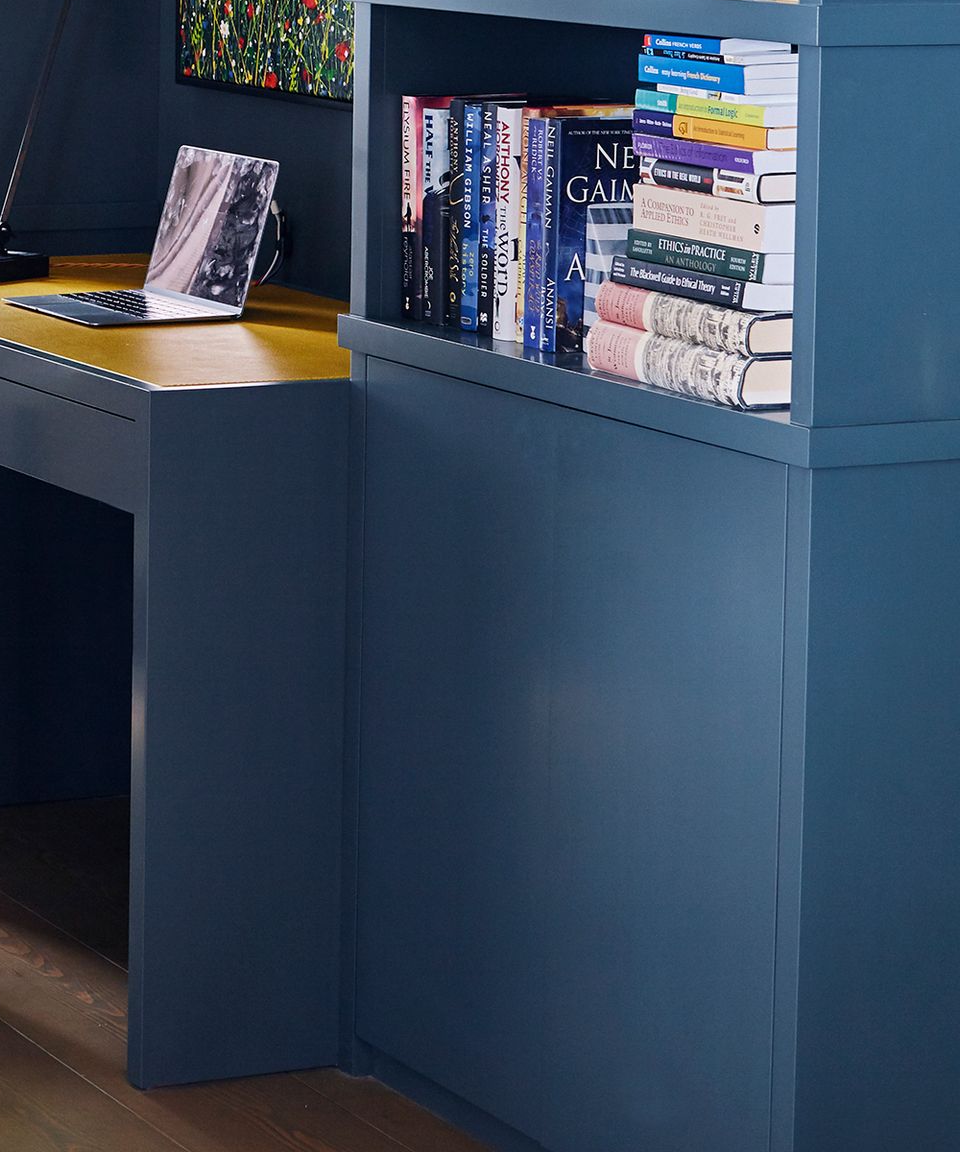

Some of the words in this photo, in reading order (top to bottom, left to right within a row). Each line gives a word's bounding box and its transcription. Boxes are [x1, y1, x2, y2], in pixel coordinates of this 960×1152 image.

[655, 39, 672, 47] Collins
[689, 42, 702, 50] VERBS
[644, 65, 659, 75] Collins
[661, 69, 671, 77] easy
[670, 68, 687, 80] learning
[687, 71, 701, 80] French
[700, 72, 721, 85] Dictionary
[707, 105, 725, 116] Formal
[725, 108, 738, 119] Logic
[425, 115, 434, 159] HALF
[465, 113, 474, 172] WILLIAM
[483, 111, 493, 149] NEAL
[547, 126, 556, 159] NEIL
[500, 122, 511, 205] ANTHONY
[594, 143, 641, 170] NE
[482, 156, 492, 205] ASHER
[654, 168, 667, 176] ETHICS
[667, 170, 672, 178] IN
[679, 172, 688, 182] REAL
[689, 174, 701, 184] WORLD
[464, 178, 472, 229] GIBSON
[545, 166, 555, 229] GAIMAN
[566, 176, 634, 204] GAIM
[641, 198, 647, 208] A
[647, 199, 685, 216] COMPANION
[686, 208, 695, 217] TO
[641, 209, 666, 222] APPLIED
[667, 213, 689, 227] ETHICS
[700, 219, 737, 233] CHRISTOPHER
[718, 232, 744, 243] WELLMAN
[633, 240, 647, 248] EDITED
[658, 239, 685, 255] ETHICS
[684, 244, 692, 256] in
[691, 245, 727, 262] PRACTICE
[461, 243, 469, 297] history
[481, 253, 489, 298] SOLDIER
[665, 255, 675, 265] AN
[676, 257, 717, 273] ANTHOLOGY
[729, 264, 746, 272] EDITION
[630, 268, 638, 277] The
[640, 269, 661, 283] Blackwell
[661, 273, 675, 286] Guide
[675, 277, 682, 286] to
[681, 278, 698, 290] Ethical
[698, 280, 716, 296] Theory
[546, 278, 556, 329] ANANSI
